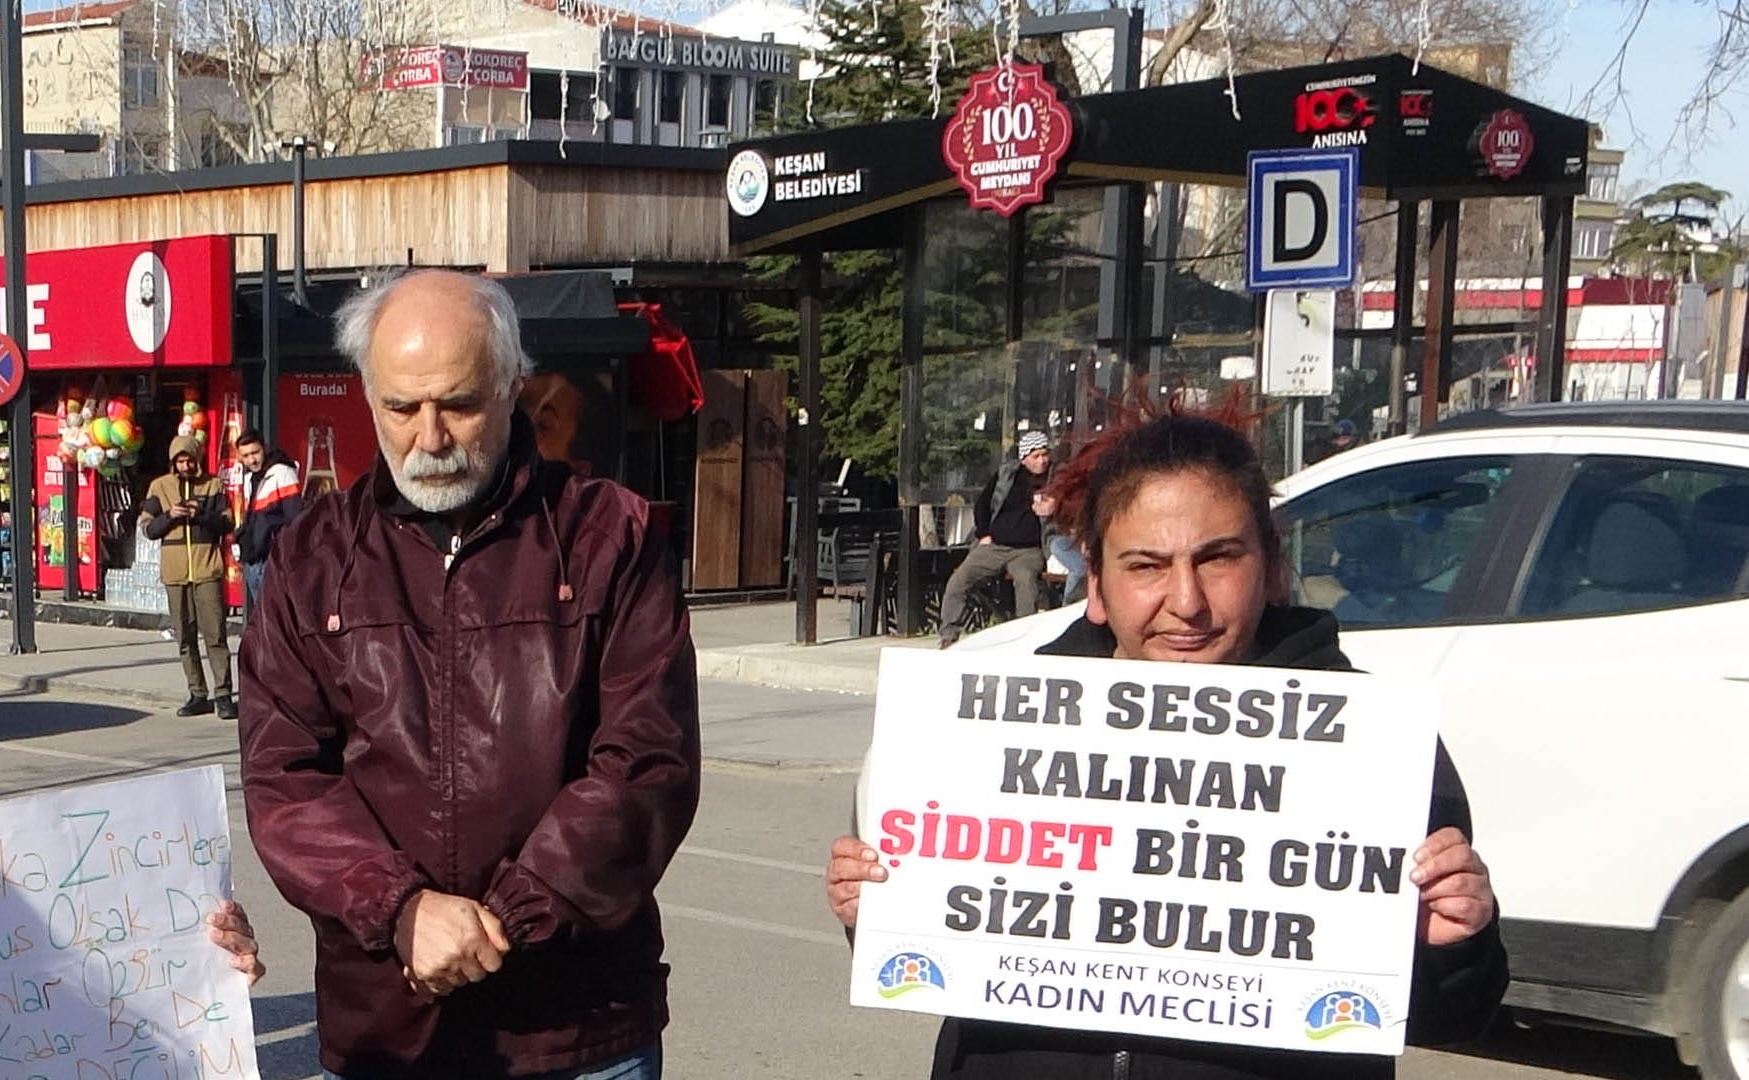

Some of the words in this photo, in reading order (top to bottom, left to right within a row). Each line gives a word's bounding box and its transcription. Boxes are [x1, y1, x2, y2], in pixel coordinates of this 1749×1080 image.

[682, 40, 743, 70] BLOOM
[750, 46, 791, 73] SUITE
[474, 68, 514, 84] ÇORBA
[995, 143, 1018, 158] YIL
[1312, 130, 1368, 149] ANISINA
[775, 152, 825, 176] KEŞAN
[980, 172, 1031, 190] MEYDANI
[775, 169, 861, 201] BELEDİYESİ
[1273, 179, 1328, 262] D
[300, 383, 347, 396] Burada!
[957, 674, 1083, 725] HER
[1106, 679, 1347, 743] SESSİZ
[1000, 747, 1286, 812] KALINAN
[880, 800, 1112, 868] ŞİDDET
[1132, 819, 1245, 882] BİR
[1269, 830, 1406, 894] GÜN
[945, 876, 1073, 940] SİZİ
[1095, 896, 1315, 961] BULUR
[999, 955, 1076, 976] KEŞAN
[1085, 961, 1149, 983] KENT
[1157, 967, 1263, 994] KONSEYİ
[172, 991, 229, 1029] De
[985, 979, 1110, 1014] KADIN
[1120, 990, 1273, 1031] MECLİSİ
